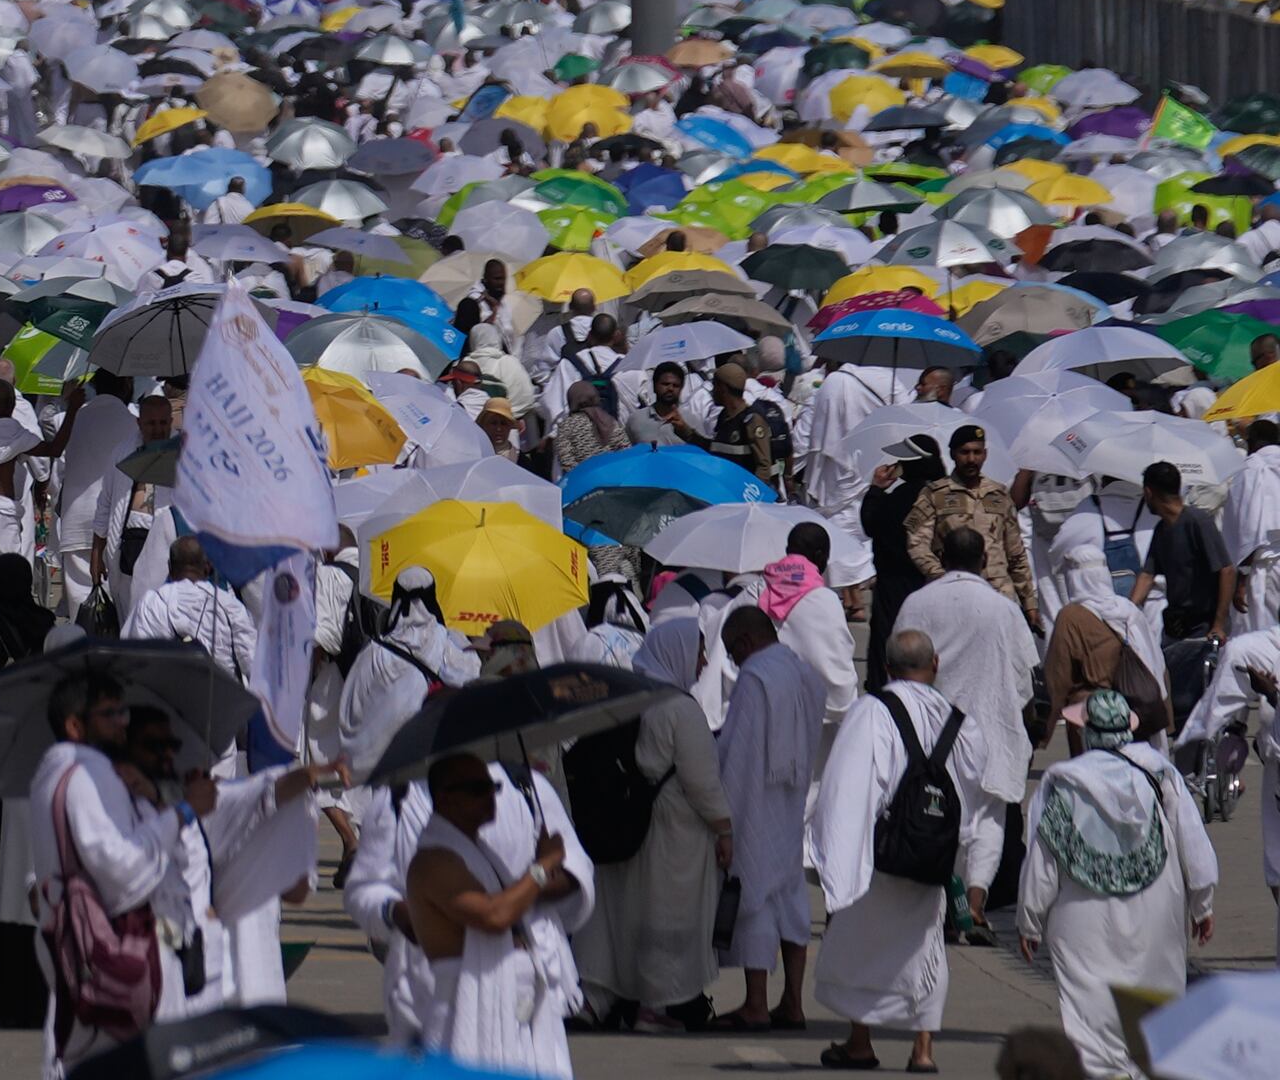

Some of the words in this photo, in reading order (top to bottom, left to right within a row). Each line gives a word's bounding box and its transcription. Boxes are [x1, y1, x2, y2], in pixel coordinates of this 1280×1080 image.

[205, 372, 255, 428] HAJJ
[244, 427, 295, 482] 2026
[456, 611, 501, 623] DHL
